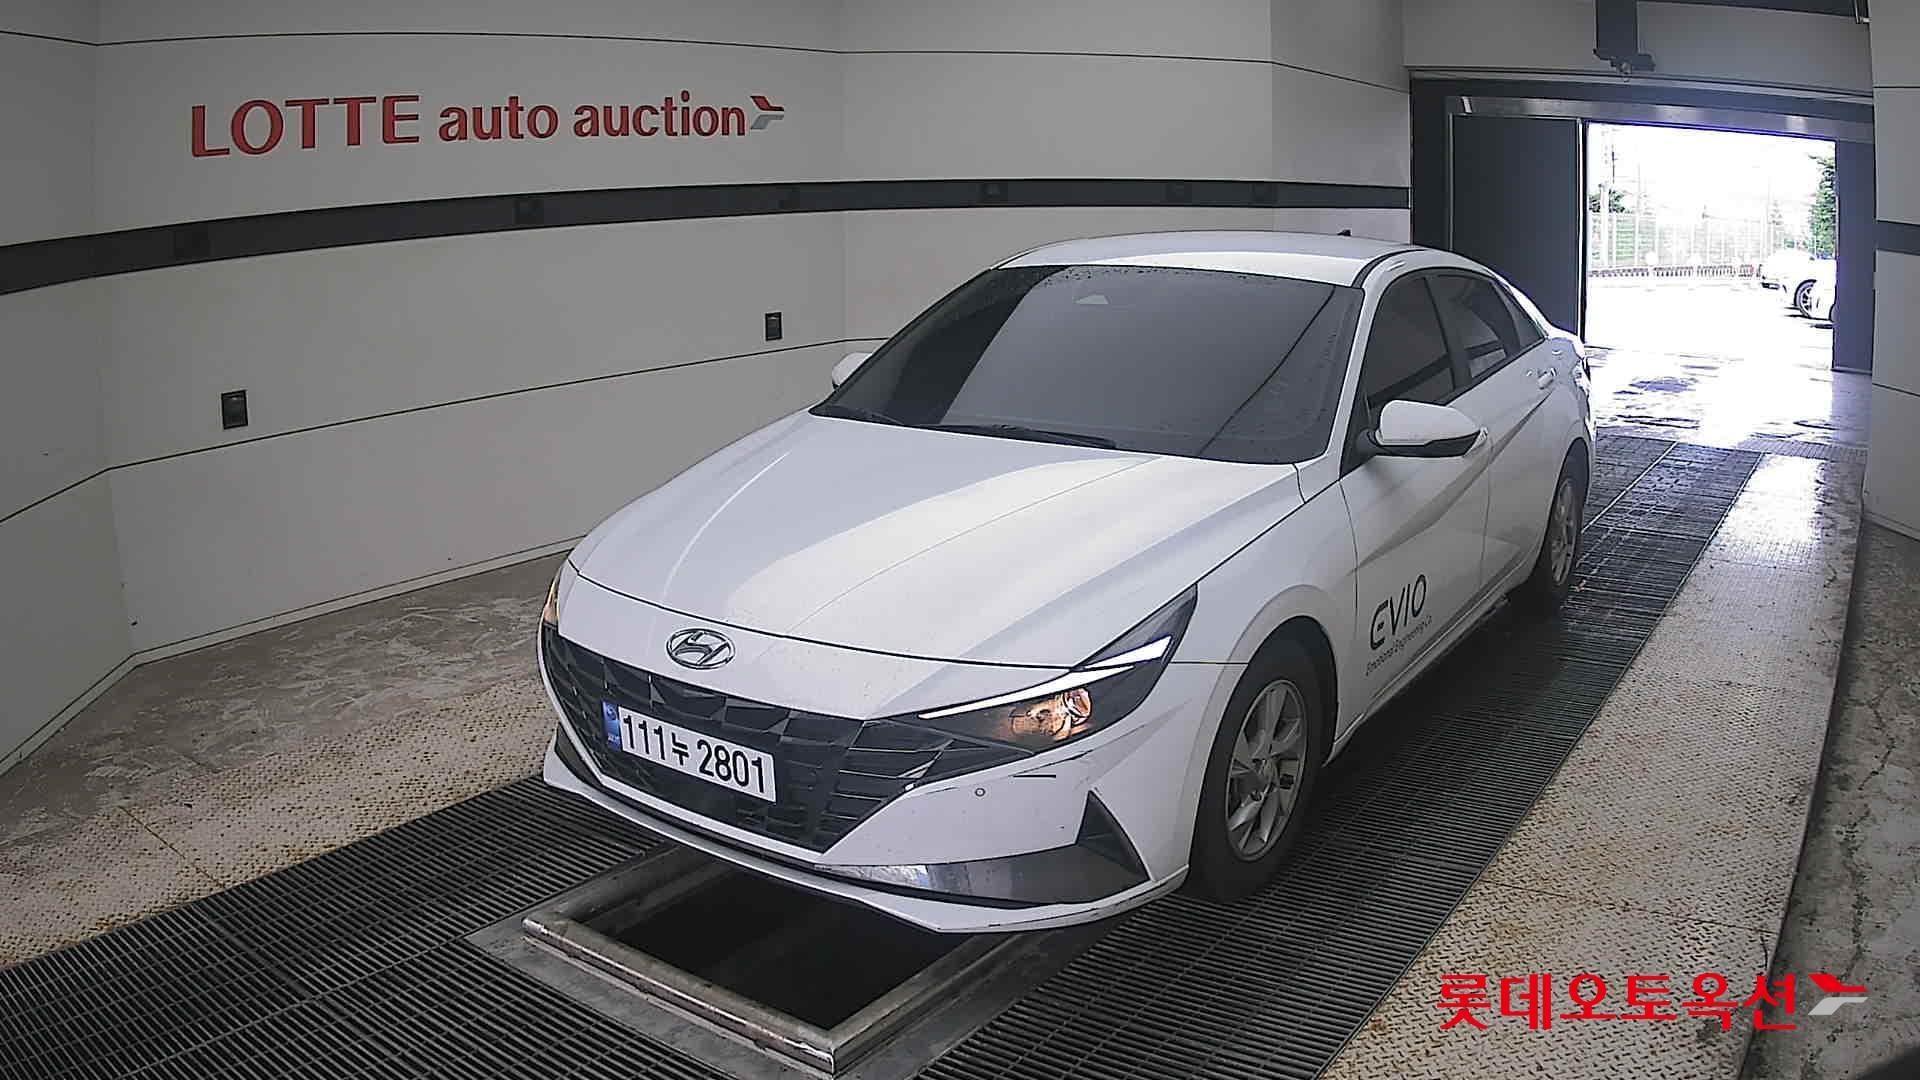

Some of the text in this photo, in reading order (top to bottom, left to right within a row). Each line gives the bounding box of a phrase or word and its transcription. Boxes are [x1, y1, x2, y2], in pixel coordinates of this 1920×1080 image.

[192, 90, 746, 158] LOTTE auto auction
[1370, 574, 1426, 650] EVIO
[623, 714, 766, 794] 111누 2801
